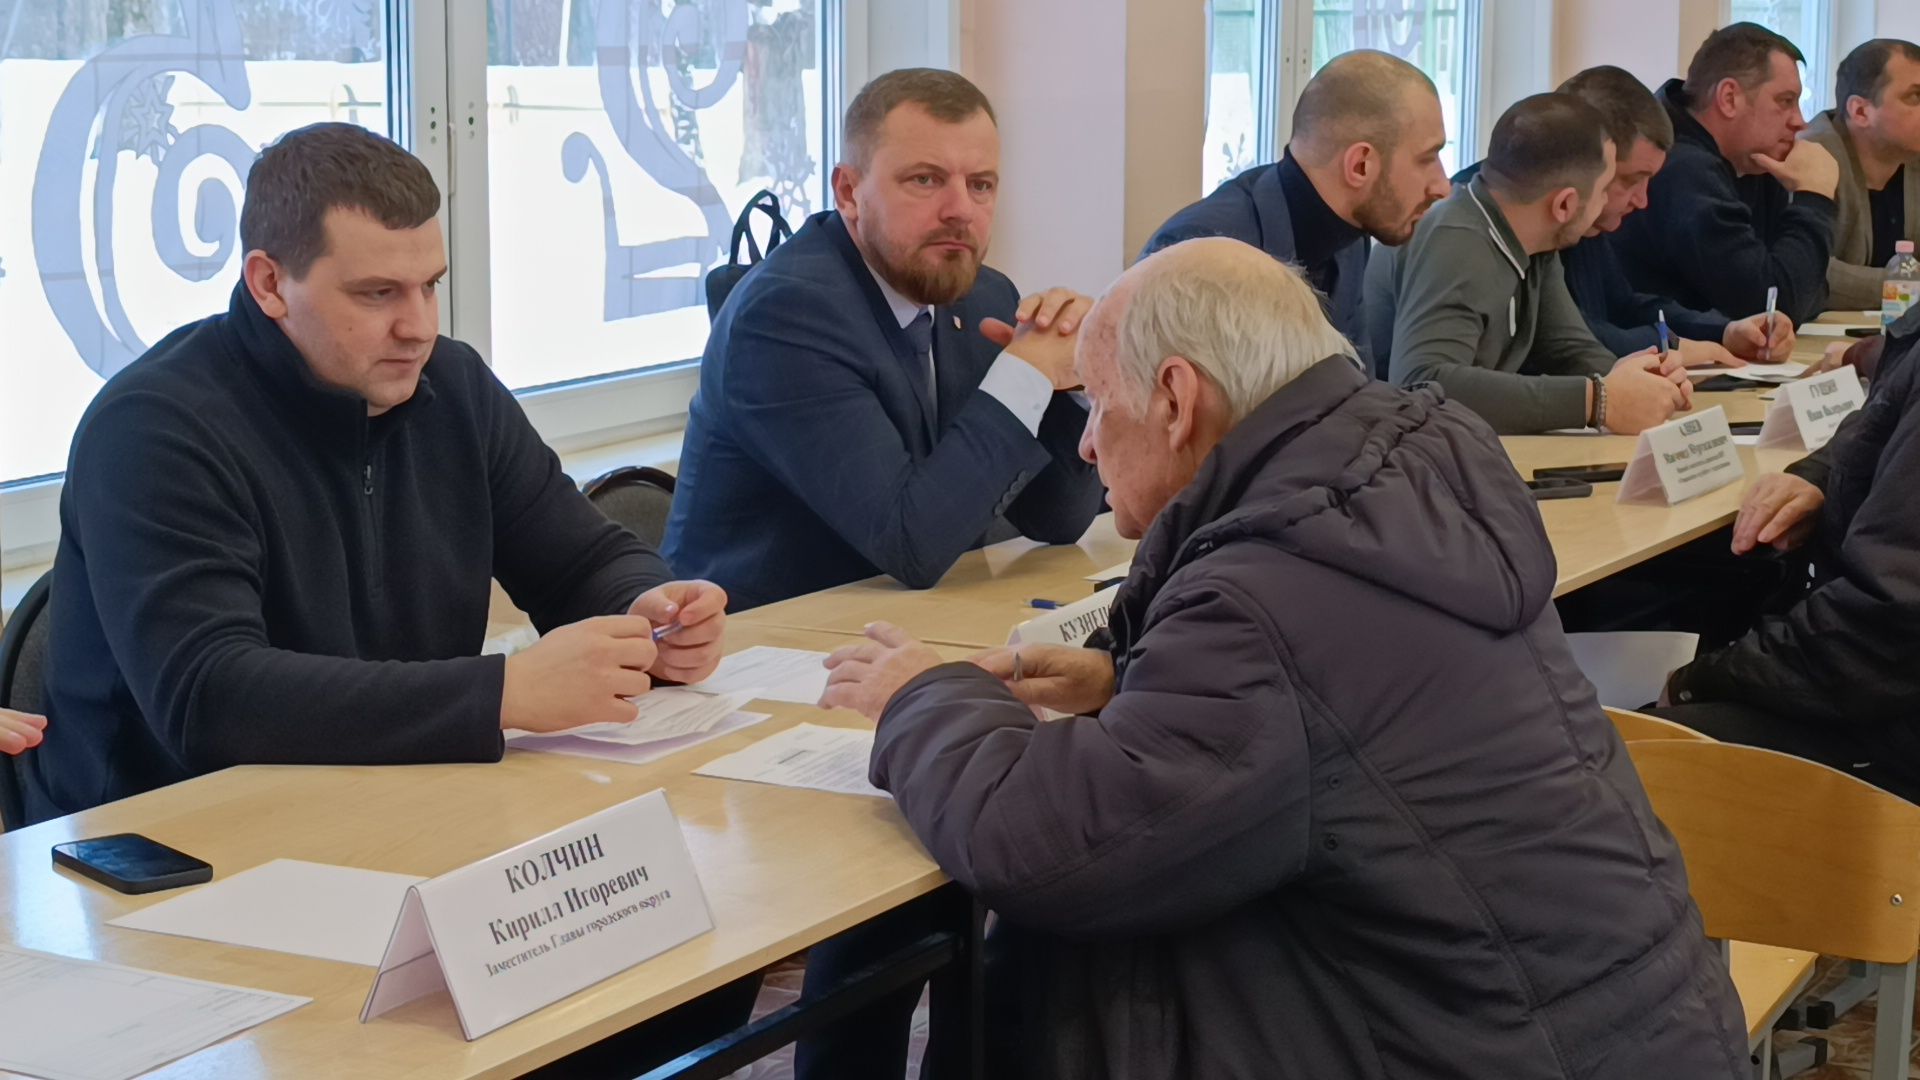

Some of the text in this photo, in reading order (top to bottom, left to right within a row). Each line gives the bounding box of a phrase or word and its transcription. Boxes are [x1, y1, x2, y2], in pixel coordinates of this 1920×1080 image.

[504, 833, 605, 893] КОЛЧИН
[488, 866, 650, 945] Кирилл Игоревич
[485, 943, 551, 977] Заместитель
[550, 926, 585, 950] Главы
